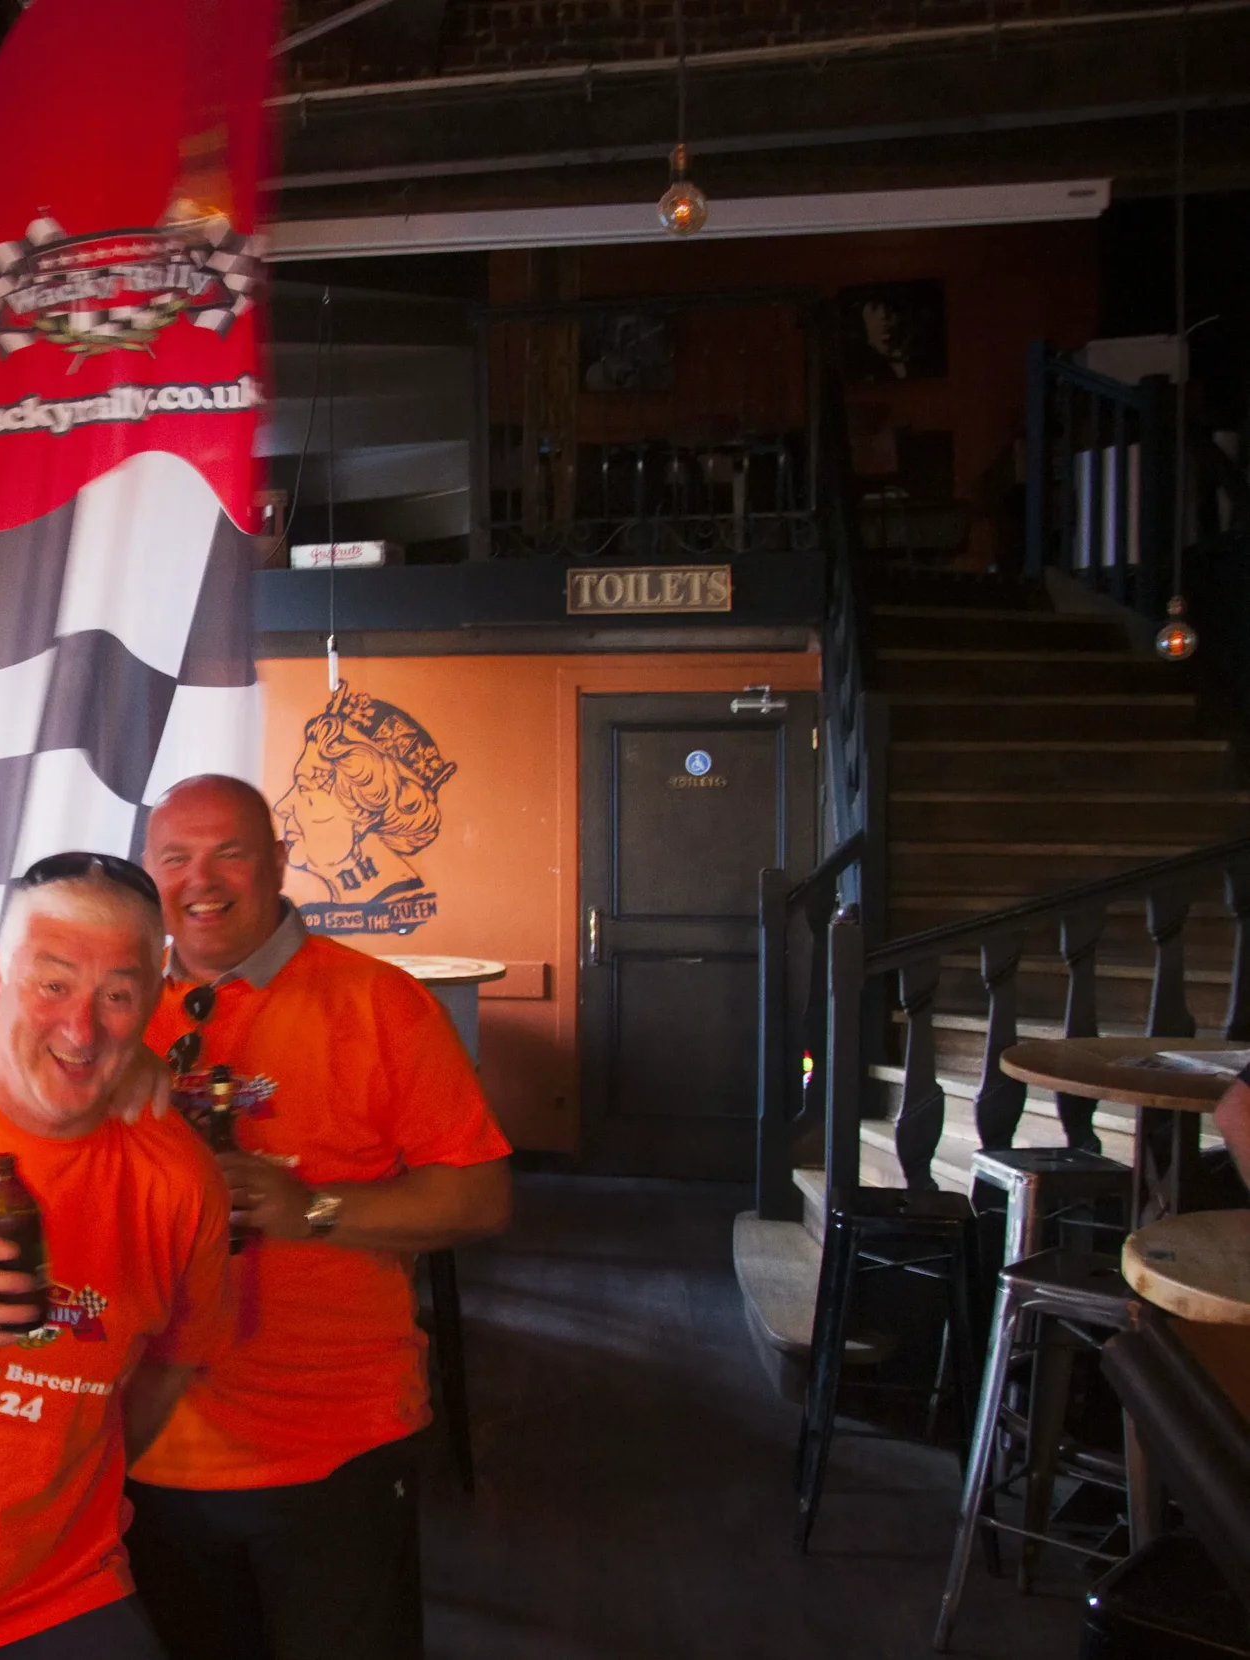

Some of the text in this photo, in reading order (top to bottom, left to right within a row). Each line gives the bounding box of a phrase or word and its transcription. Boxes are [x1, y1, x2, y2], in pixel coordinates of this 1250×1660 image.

[6, 276, 116, 314] Wacky
[572, 571, 727, 607] TOILETS
[302, 901, 437, 930] OD Save THE QUEEN
[47, 1307, 82, 1325] ally
